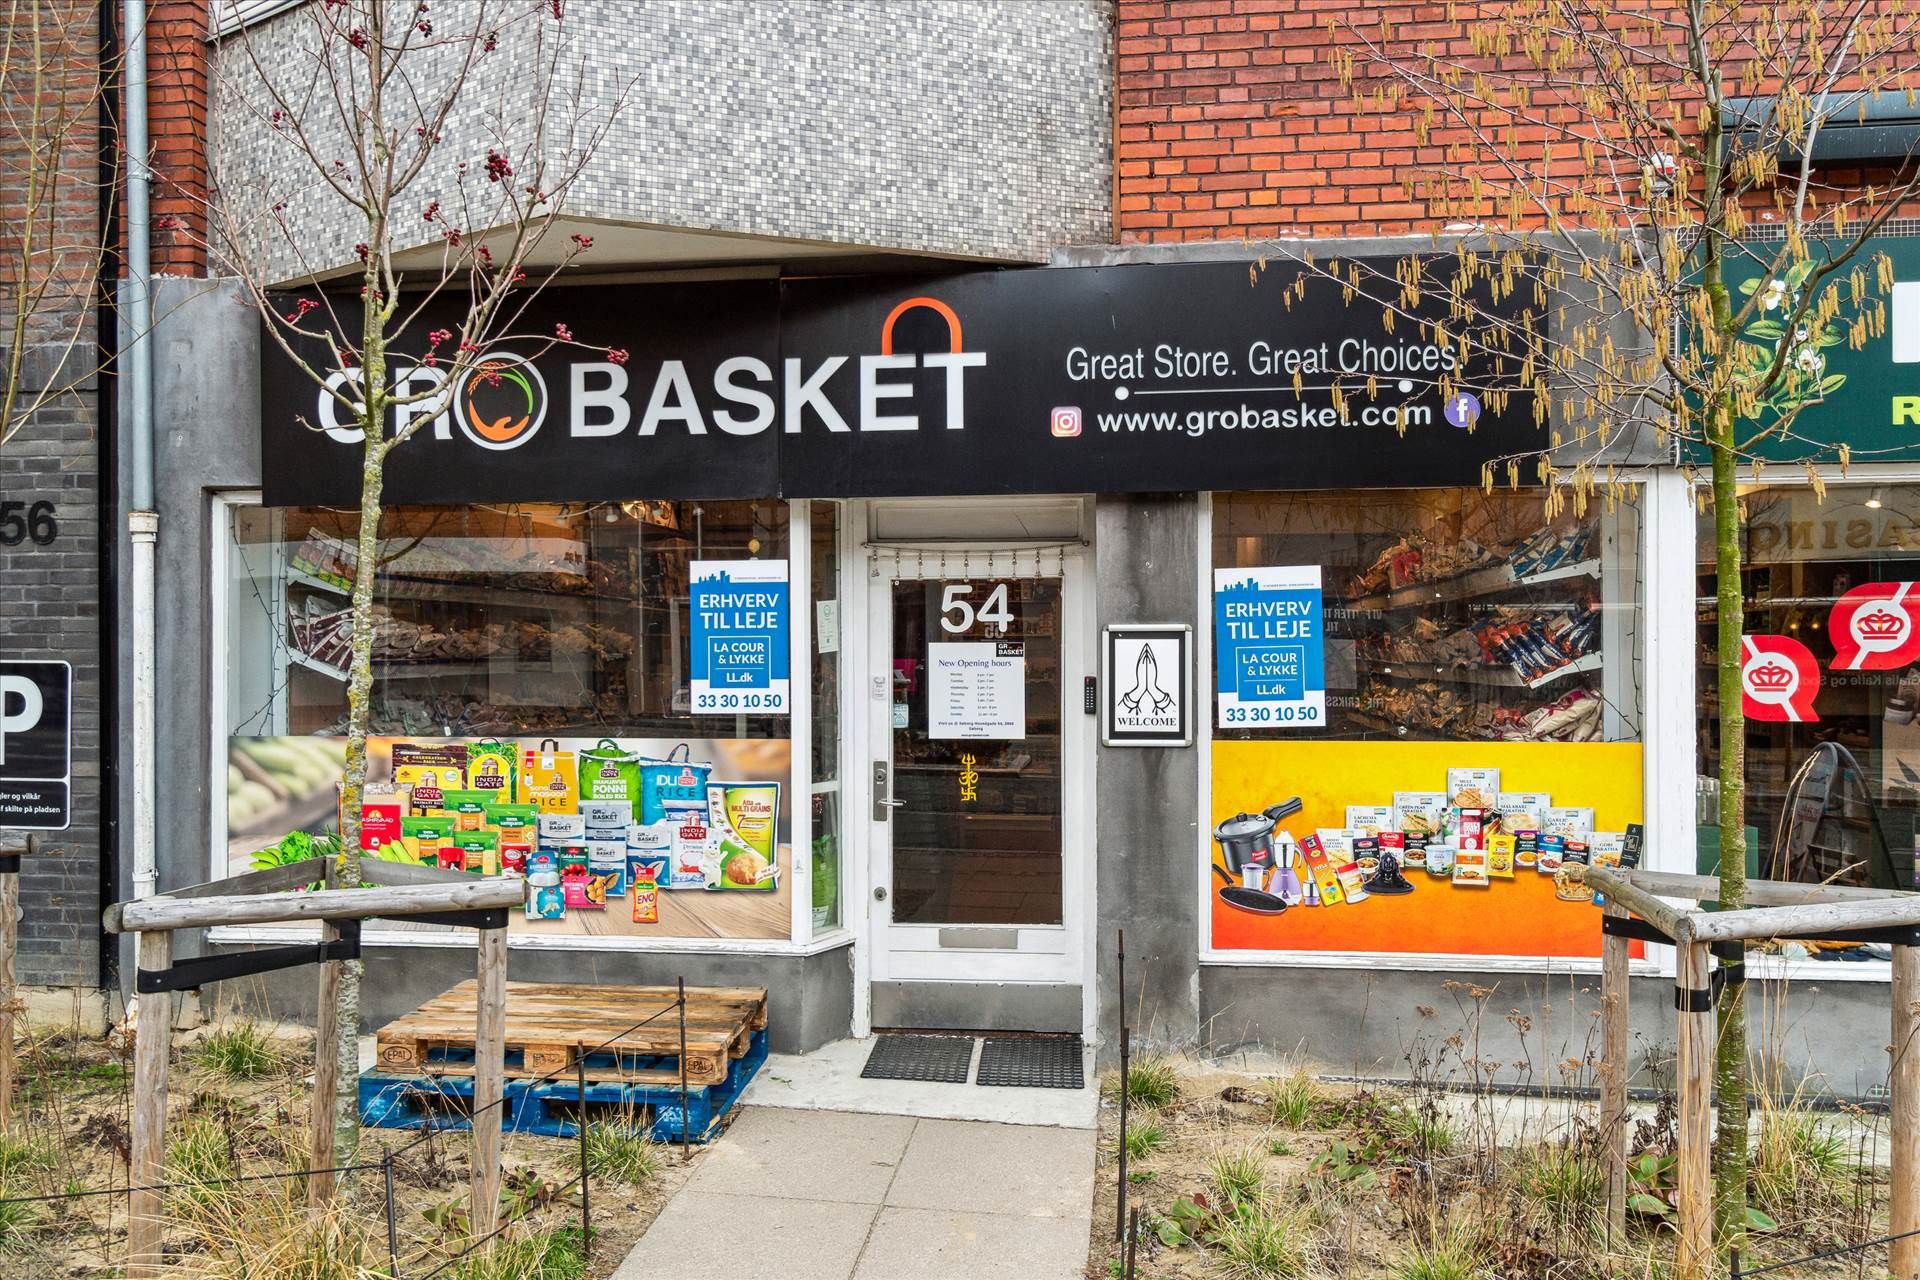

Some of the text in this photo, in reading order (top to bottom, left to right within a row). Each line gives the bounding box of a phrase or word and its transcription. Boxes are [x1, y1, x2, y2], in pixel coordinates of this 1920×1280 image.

[1066, 345, 1144, 380] Great
[1155, 343, 1236, 377] Store.
[1248, 340, 1328, 375] Great
[570, 352, 987, 437] BASKET
[1097, 402, 1431, 436] www.grobasket.com
[0, 500, 58, 545] 56
[700, 593, 779, 608] ERHVERV
[940, 583, 1015, 633] 54
[1226, 601, 1312, 618] ERHVERV
[700, 612, 778, 629] TIL LEJE
[1226, 620, 1312, 640] TIL LEJE
[714, 643, 765, 653] LA COUR
[718, 655, 765, 664] & LYKKE
[938, 659, 1012, 669] New Opening hours
[1242, 653, 1297, 664] LA COUR
[1247, 665, 1298, 676] & LYKKE
[726, 672, 753, 683] LL.dk
[1257, 684, 1286, 695] LL.dk
[698, 695, 782, 707] 33 30 10 50
[1226, 706, 1318, 722] 33 30 10 50
[0, 675, 43, 766] P
[1117, 717, 1177, 726] WELCOME
[593, 784, 627, 794] PONNI
[656, 787, 696, 797] RICE
[11, 793, 21, 801] og
[529, 798, 567, 806] RICE
[5, 805, 23, 813] skilte
[24, 805, 33, 814] på
[34, 805, 61, 814] pladsen
[637, 893, 655, 905] ENO
[387, 1050, 408, 1060] EPAL
[688, 1060, 708, 1071] EPAL
